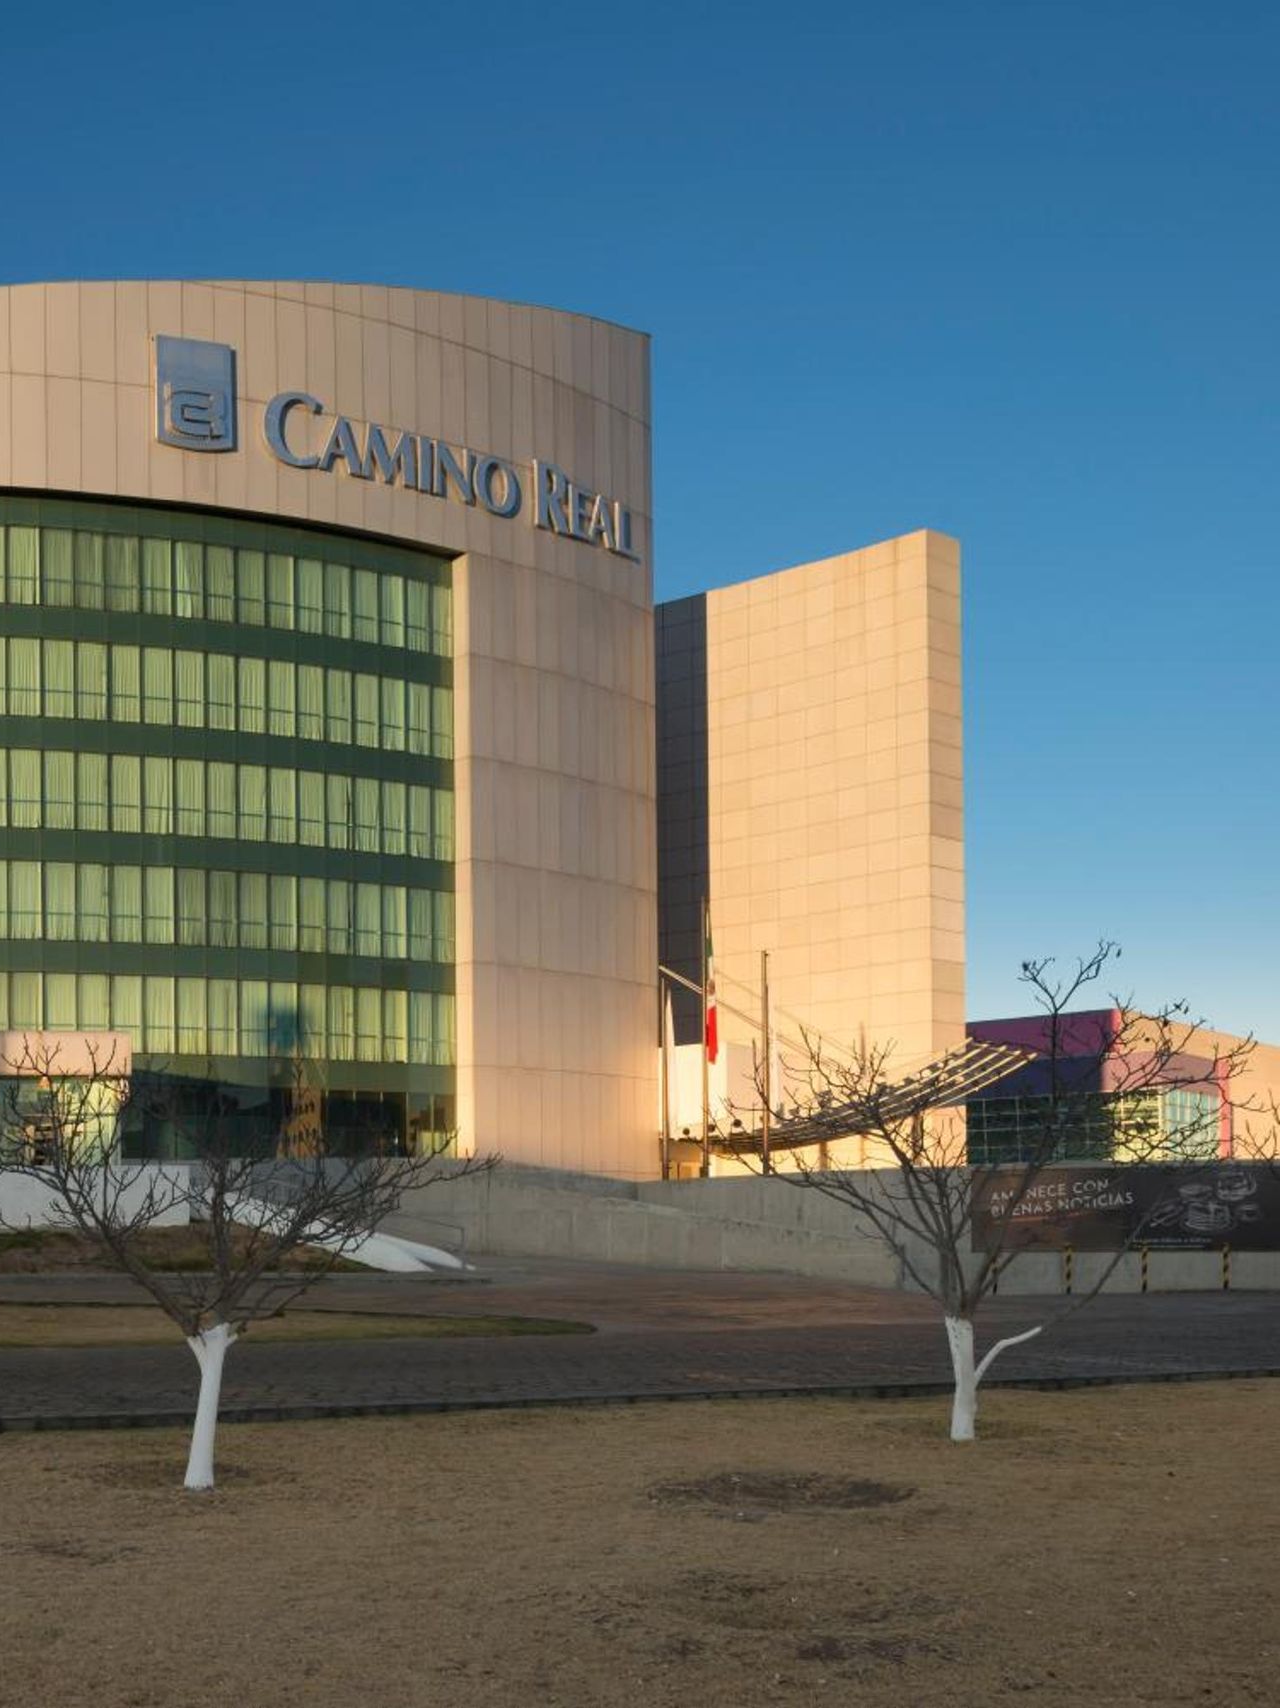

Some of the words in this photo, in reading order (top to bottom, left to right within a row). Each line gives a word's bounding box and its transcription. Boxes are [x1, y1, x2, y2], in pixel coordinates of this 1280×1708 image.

[263, 391, 521, 518] CAMINO
[532, 457, 640, 563] REAL
[991, 1183, 1066, 1200] AMNECE
[1072, 1178, 1109, 1195] CON
[1057, 1191, 1135, 1210] NOTICIAS
